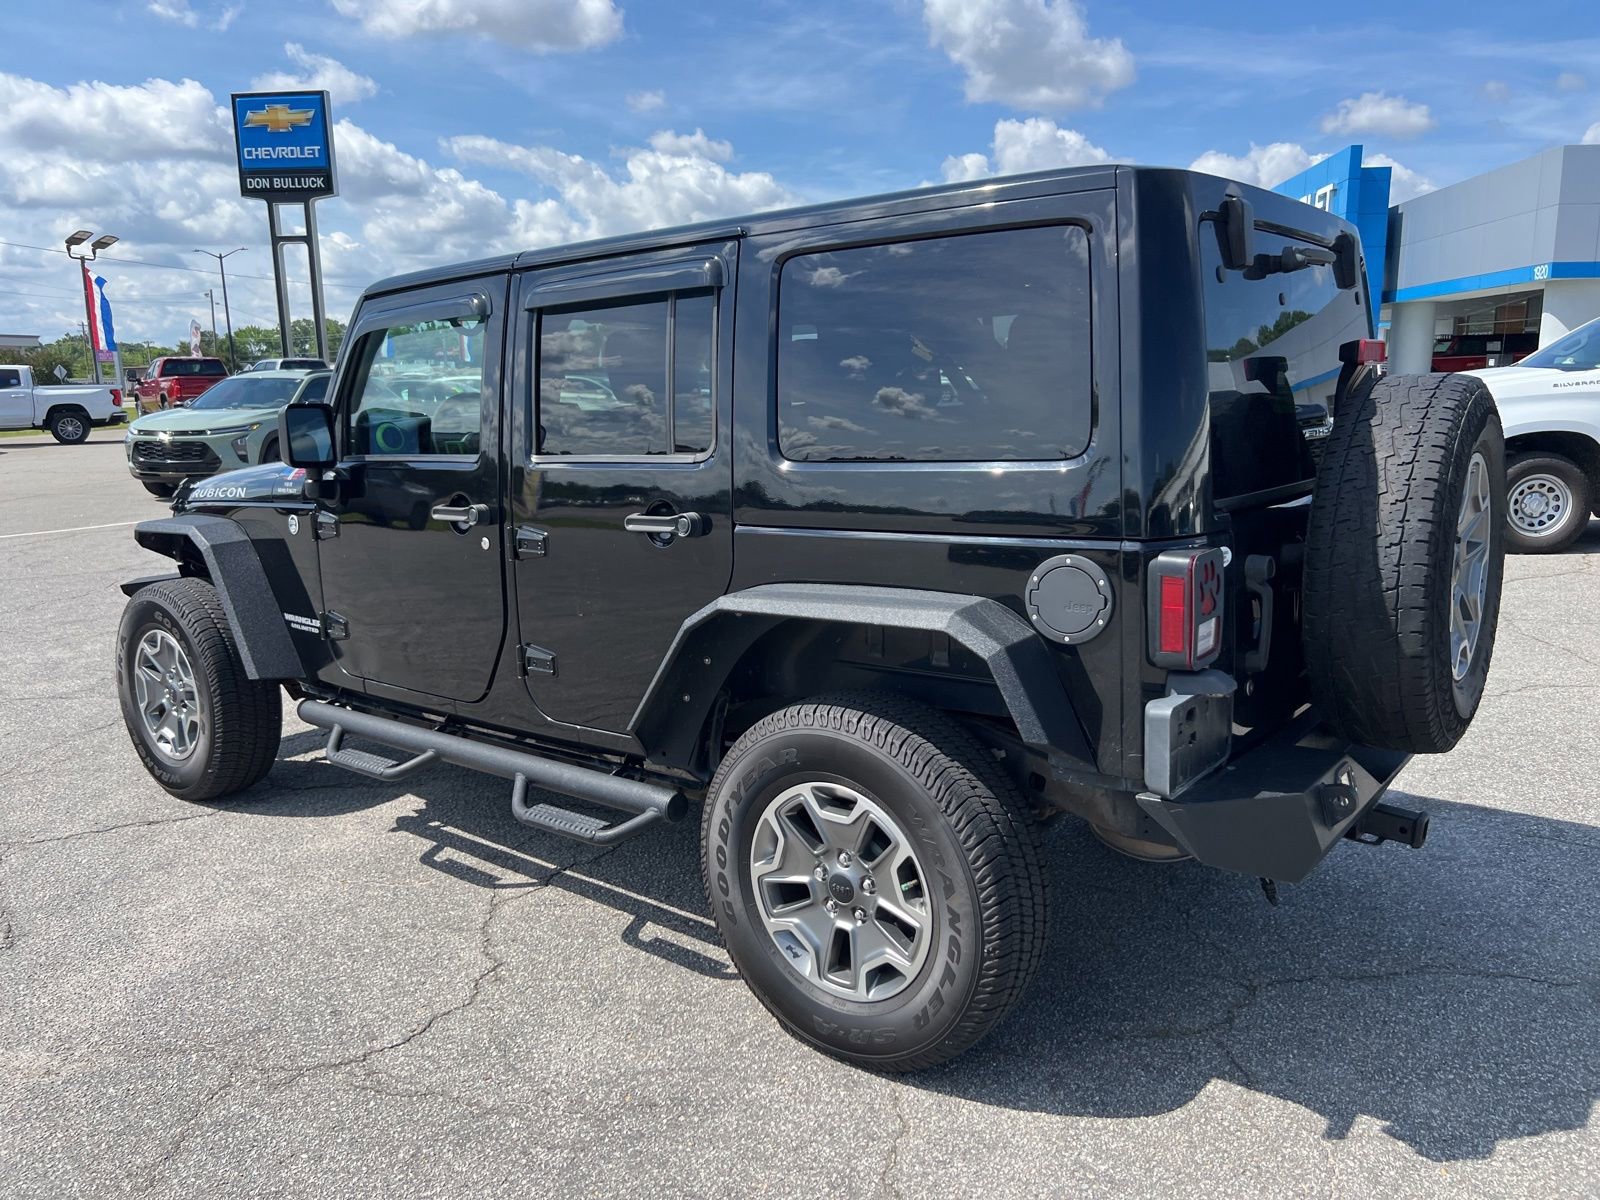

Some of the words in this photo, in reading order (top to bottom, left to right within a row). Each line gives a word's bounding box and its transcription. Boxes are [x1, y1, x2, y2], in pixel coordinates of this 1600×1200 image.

[243, 145, 321, 160] CHEVROLET
[246, 178, 270, 189] DON
[273, 177, 325, 189] BULLUCK
[1533, 264, 1549, 280] 1920
[192, 487, 247, 499] RUBICON
[283, 612, 321, 628] WRANGLE
[290, 622, 320, 634] UNLIMITED
[716, 747, 799, 926] GOODYEAR
[906, 805, 963, 1031] WRANGLER
